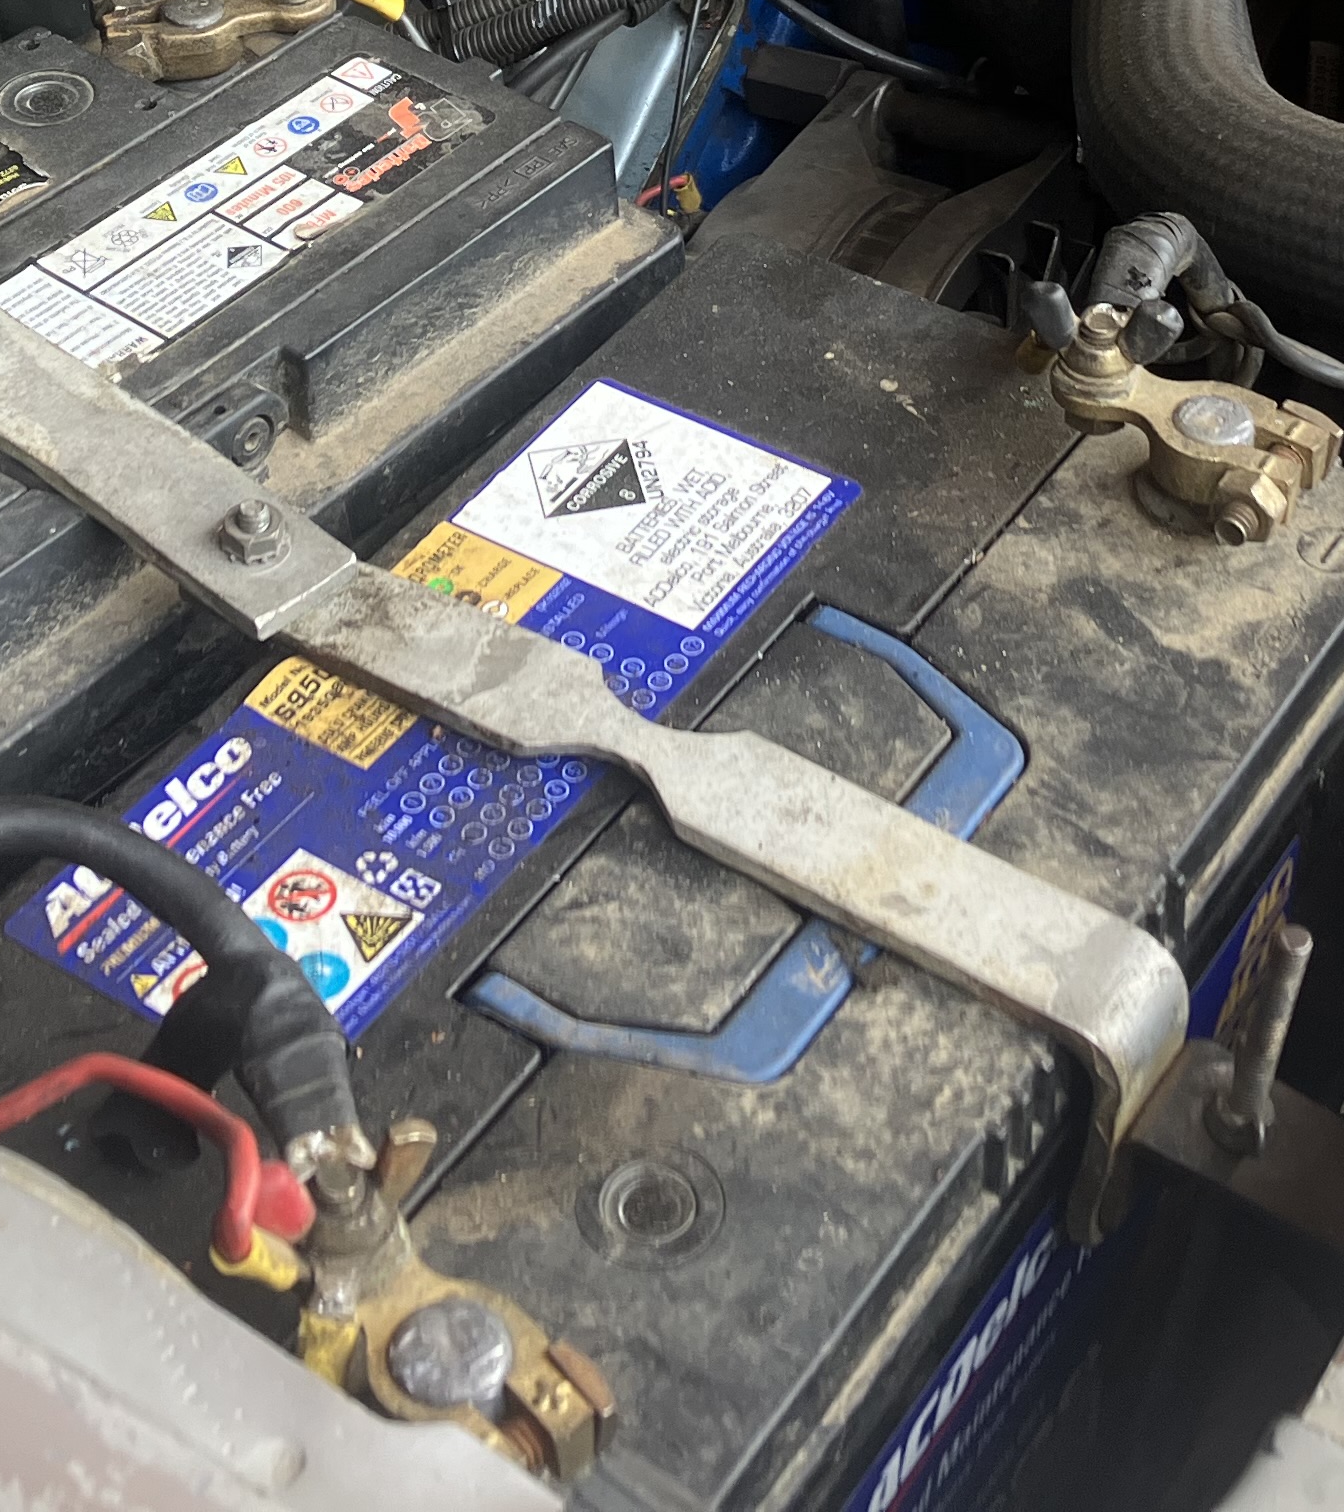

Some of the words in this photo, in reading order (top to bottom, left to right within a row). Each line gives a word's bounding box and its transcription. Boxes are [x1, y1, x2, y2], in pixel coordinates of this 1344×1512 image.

[366, 72, 402, 96] CAUTION
[270, 169, 297, 186] 105
[340, 131, 434, 197] Batteries
[221, 182, 275, 217] Minutes
[563, 451, 631, 514] CORROSIVE
[615, 485, 639, 503] 8
[631, 439, 665, 502] UN2794
[613, 491, 682, 557] BATTERIES,
[627, 525, 674, 569] FILLED
[664, 496, 702, 530] WITH
[657, 522, 703, 567] electric
[695, 484, 744, 529] storage
[689, 553, 726, 588] Port
[712, 496, 779, 560] Melbourne,
[710, 490, 759, 535] Salmon
[255, 675, 298, 709] Model
[240, 770, 284, 809] Free
[43, 735, 253, 940] ACelco
[75, 899, 144, 966] Sealed
